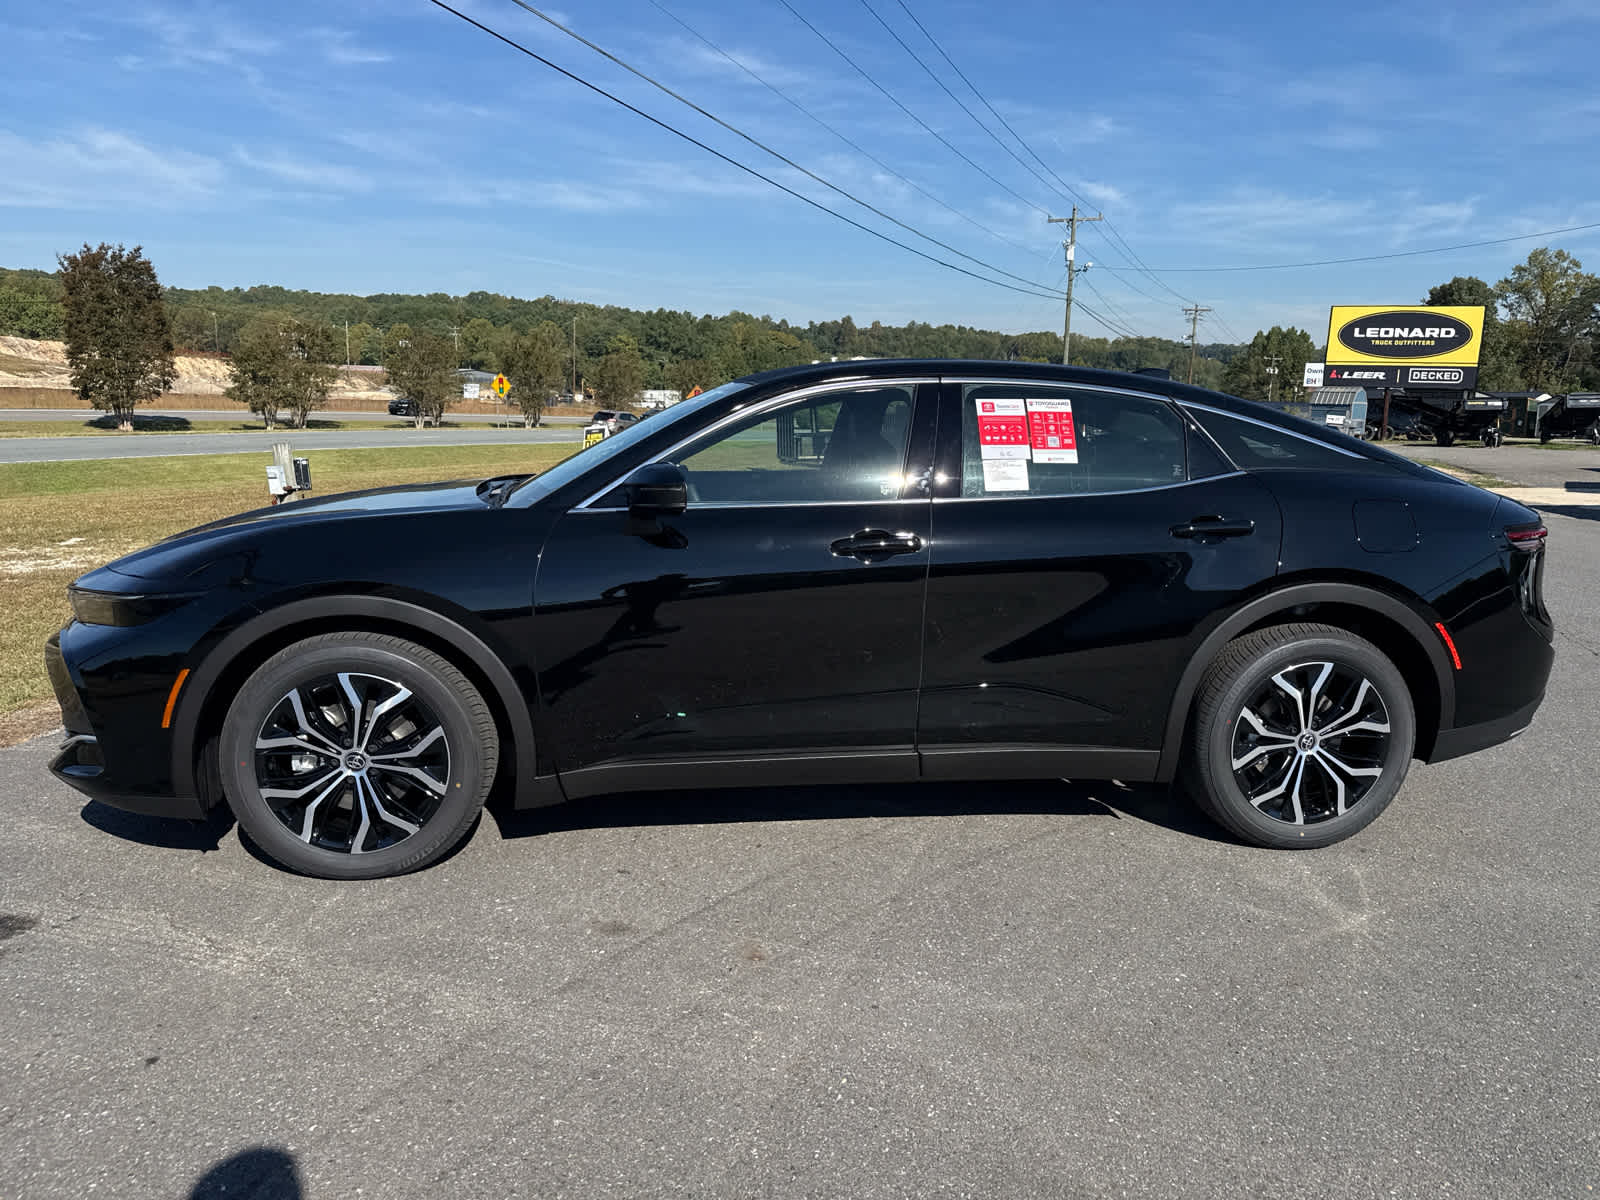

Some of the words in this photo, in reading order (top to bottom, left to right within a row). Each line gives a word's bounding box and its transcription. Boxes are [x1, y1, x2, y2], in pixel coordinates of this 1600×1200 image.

[1353, 327, 1456, 338] LEONARD
[1342, 371, 1387, 380] LEER
[1412, 371, 1460, 380] DECKED
